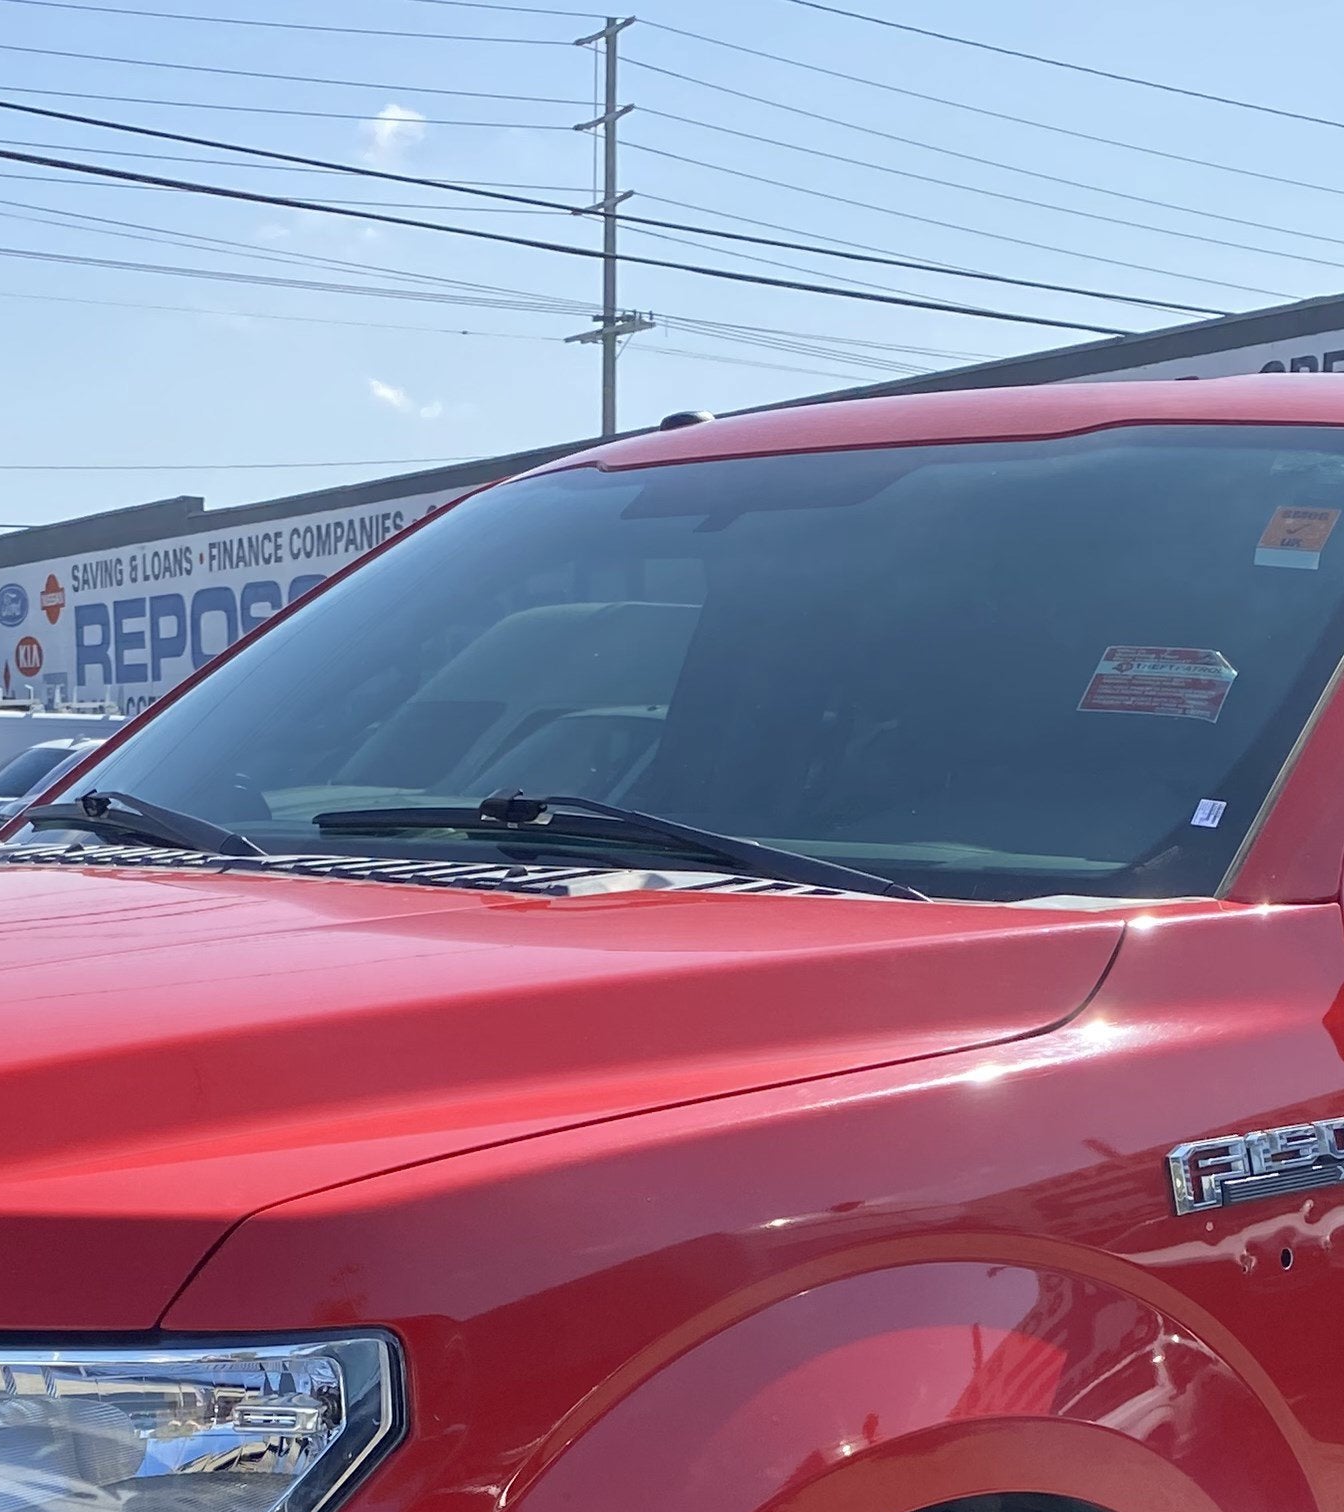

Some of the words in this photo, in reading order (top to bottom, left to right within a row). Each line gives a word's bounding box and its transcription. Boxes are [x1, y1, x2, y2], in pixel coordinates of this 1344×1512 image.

[71, 557, 124, 593] SAVING
[129, 555, 139, 584] &
[142, 545, 193, 582] LOANS
[208, 530, 284, 573] FINANCE
[288, 510, 404, 561] COMPANIES
[18, 643, 41, 669] KIA
